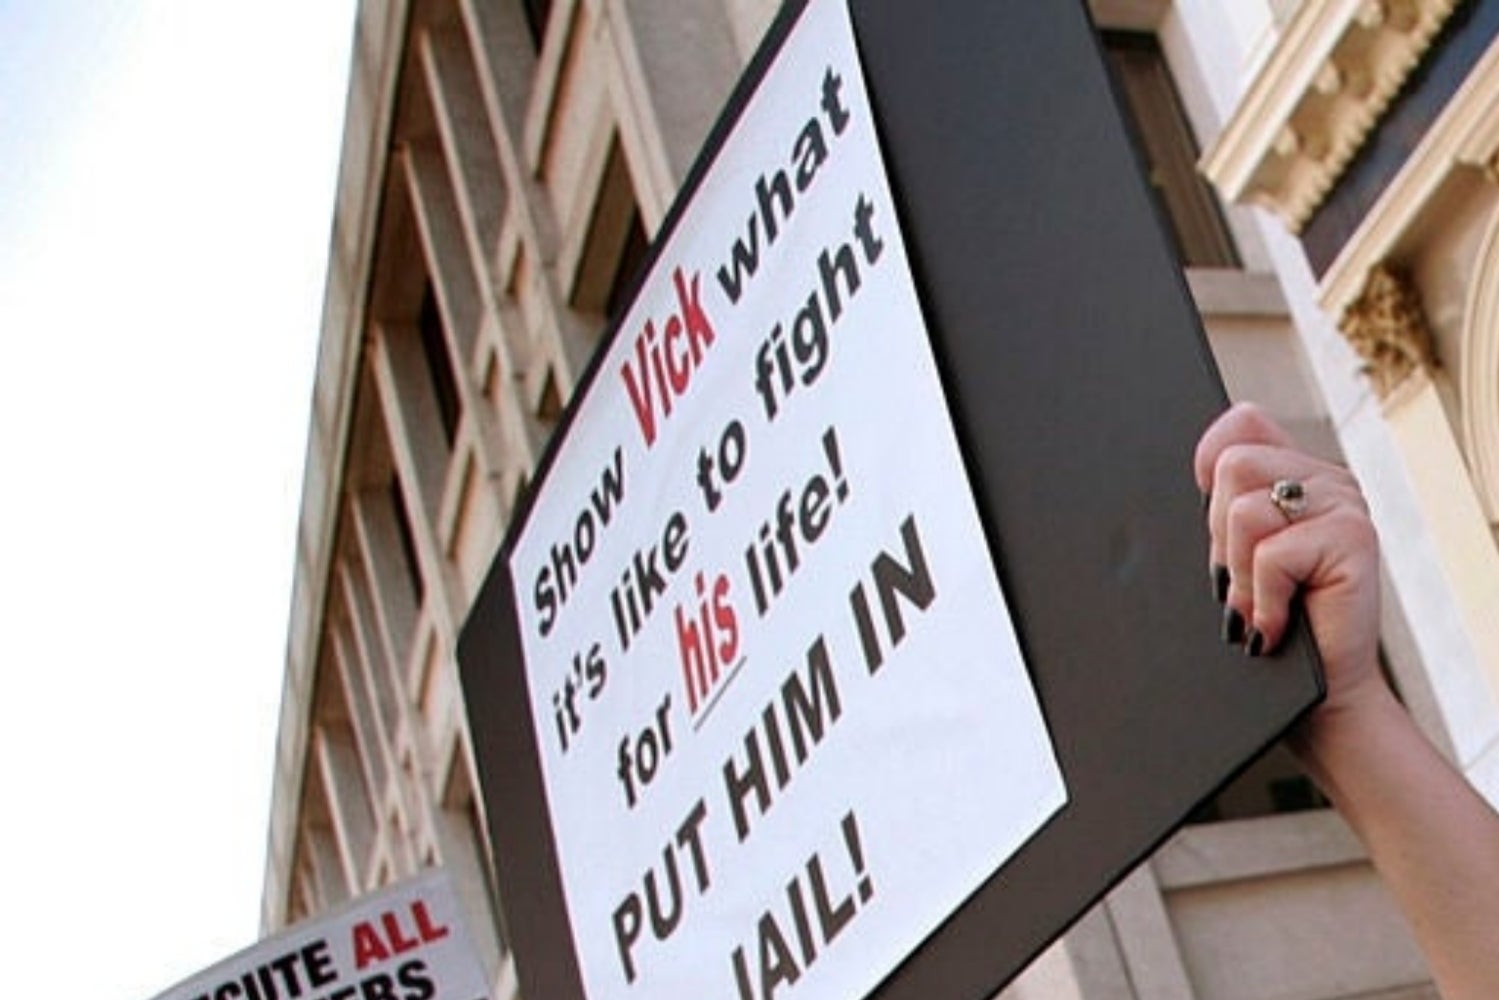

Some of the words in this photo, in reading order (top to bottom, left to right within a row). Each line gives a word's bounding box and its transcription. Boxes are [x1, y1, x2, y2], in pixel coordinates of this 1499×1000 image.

[533, 445, 624, 638] Show
[620, 266, 715, 448] Vick
[716, 67, 851, 305] what
[552, 643, 607, 754] it's
[610, 510, 689, 653] like
[696, 420, 746, 513] to
[755, 194, 883, 421] fight
[612, 799, 711, 985] PUT
[722, 634, 842, 843] HIM
[849, 514, 936, 676] IN
[617, 694, 672, 809] for
[675, 571, 738, 715] his
[745, 426, 850, 617] life!
[352, 899, 450, 971] ALL
